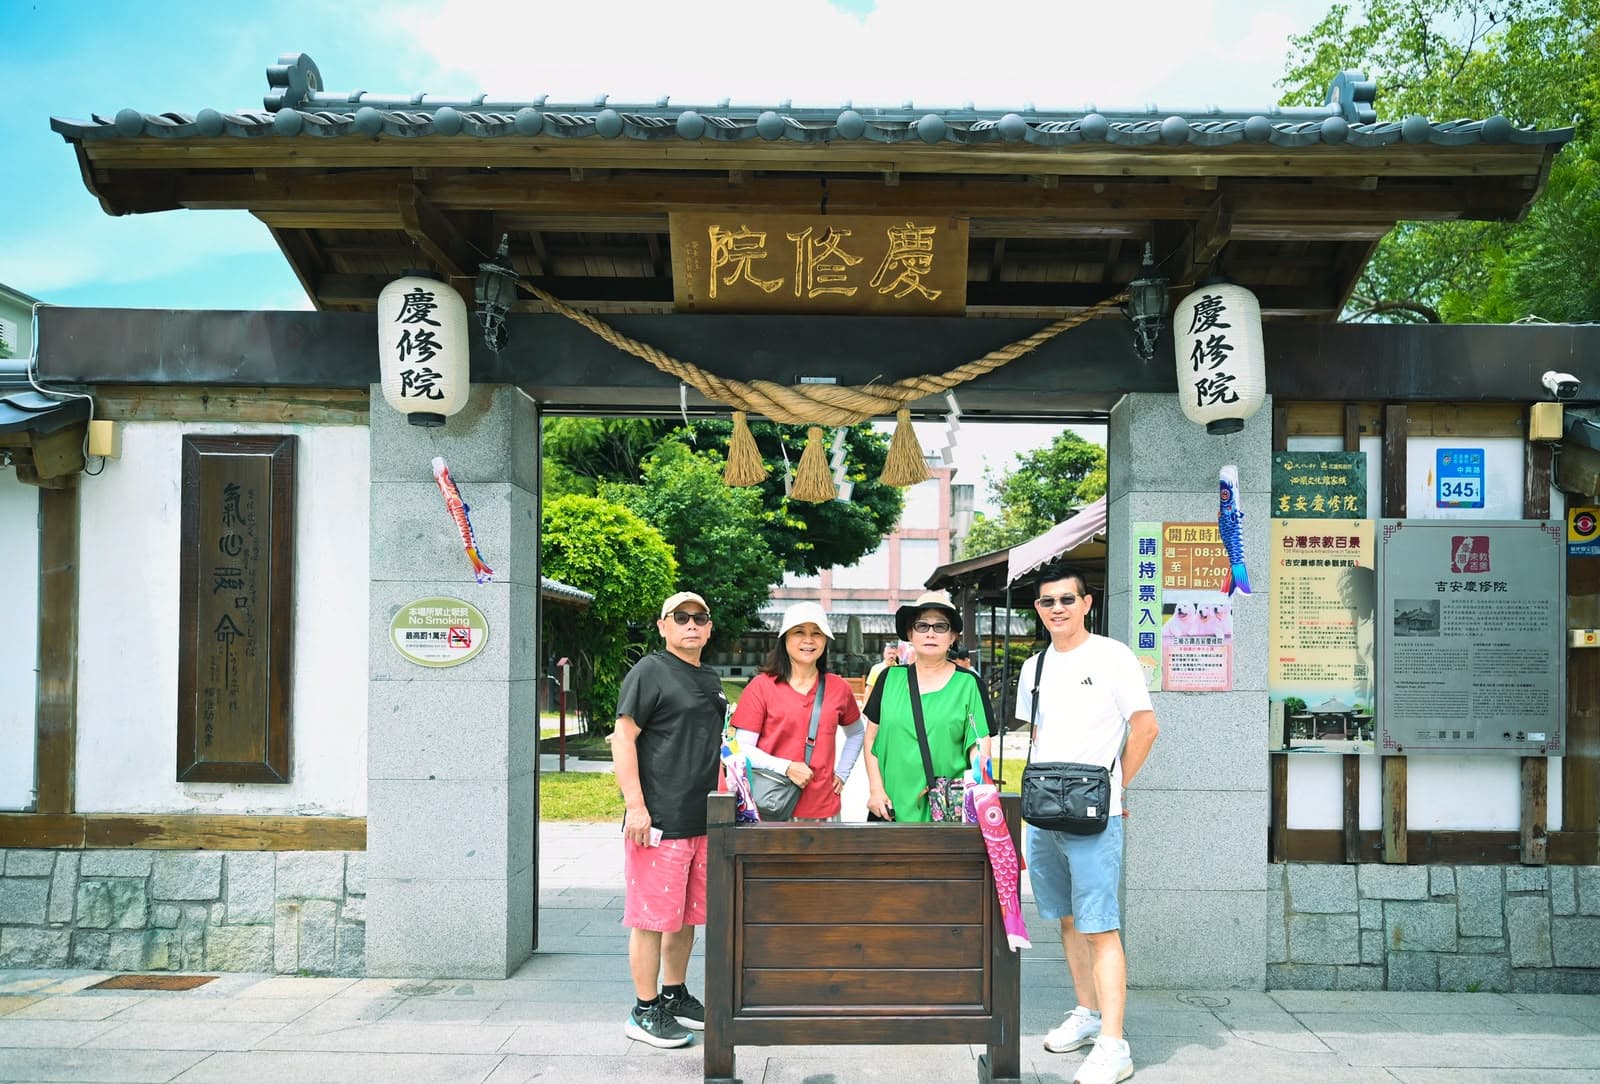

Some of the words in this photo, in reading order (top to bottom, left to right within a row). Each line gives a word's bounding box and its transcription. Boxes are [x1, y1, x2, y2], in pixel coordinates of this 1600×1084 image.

[394, 287, 445, 400] 慶修院
[1187, 294, 1240, 407] 慶修院
[1278, 494, 1358, 512] 吉安慶修院
[1282, 536, 1360, 548] 台灣宗教百景
[1165, 547, 1188, 558] 週二
[1170, 561, 1182, 572] 至
[1164, 576, 1187, 586] 週日
[1194, 579, 1224, 588] 截止入
[1434, 580, 1508, 592] 吉安慶修院
[1138, 538, 1157, 650] 請持票入園
[408, 616, 424, 624] No
[425, 616, 470, 626] Smoking
